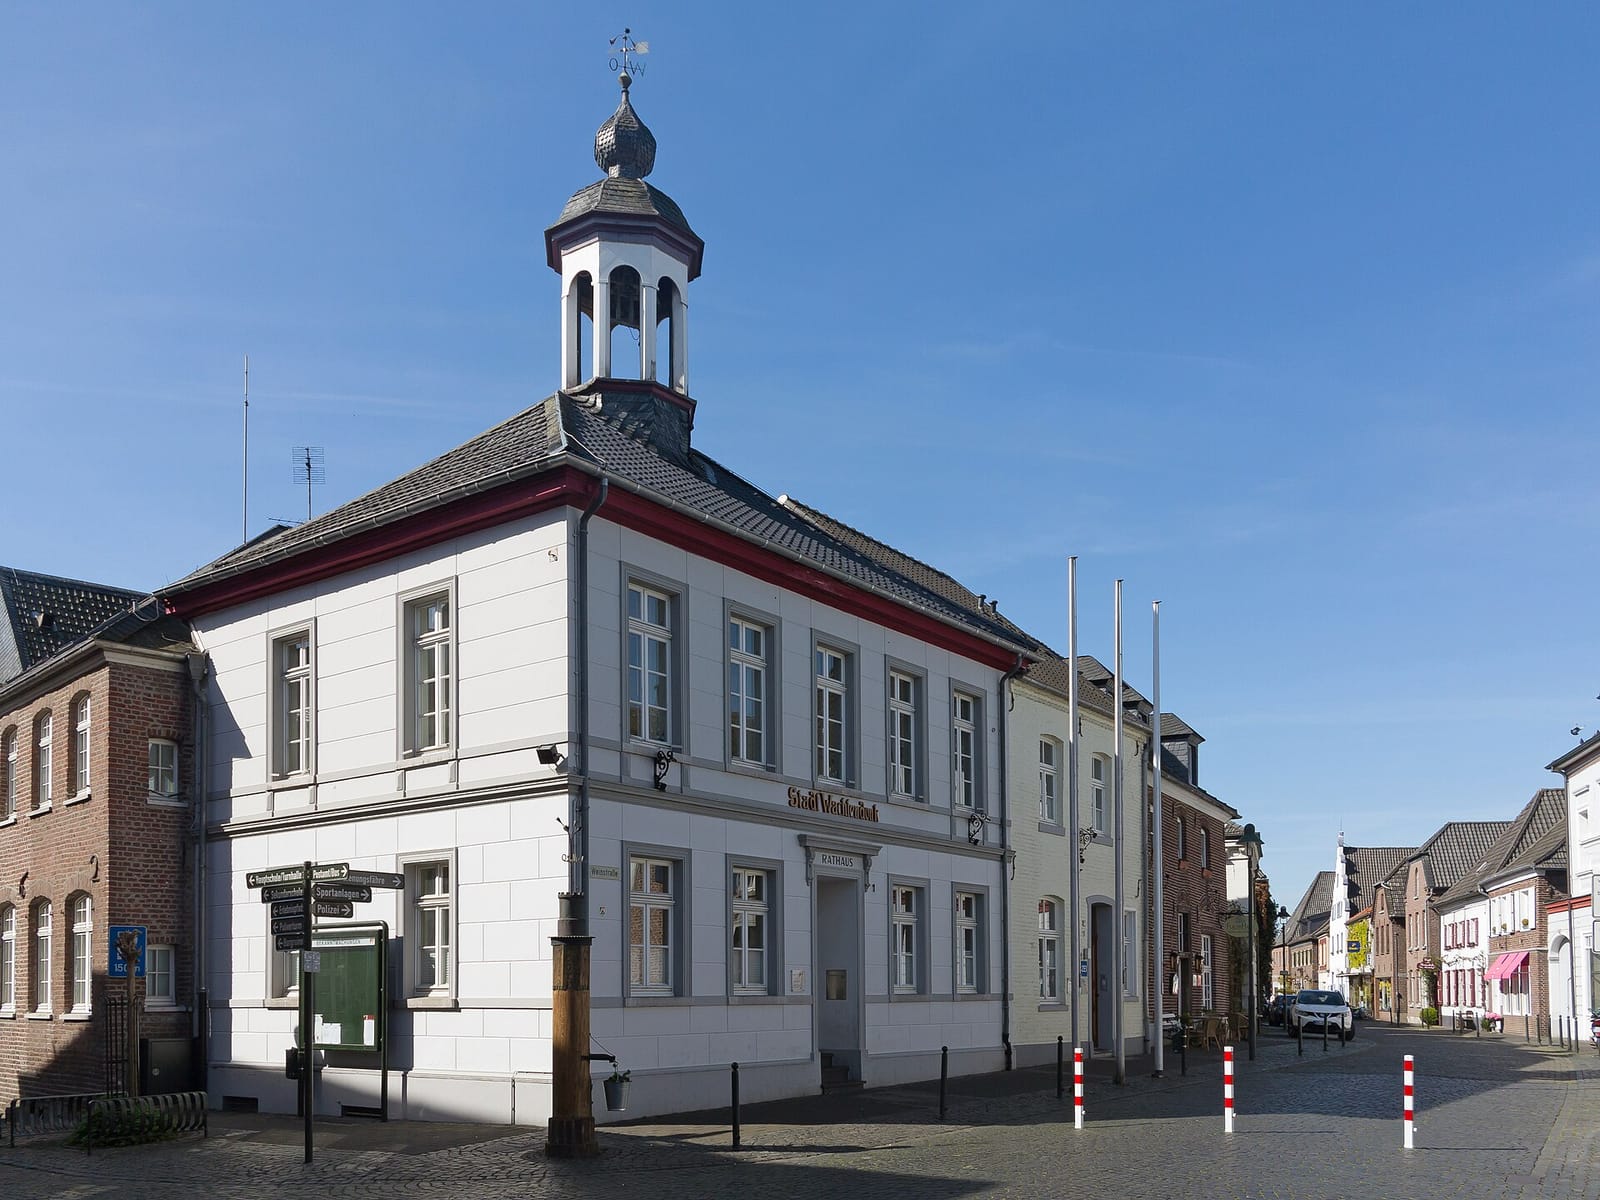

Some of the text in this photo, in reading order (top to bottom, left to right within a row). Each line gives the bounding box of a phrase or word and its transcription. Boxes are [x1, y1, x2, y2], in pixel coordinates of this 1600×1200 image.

[821, 853, 854, 867] RATHAUS
[316, 886, 361, 899] Sportanlagen
[317, 903, 340, 914] Polizei
